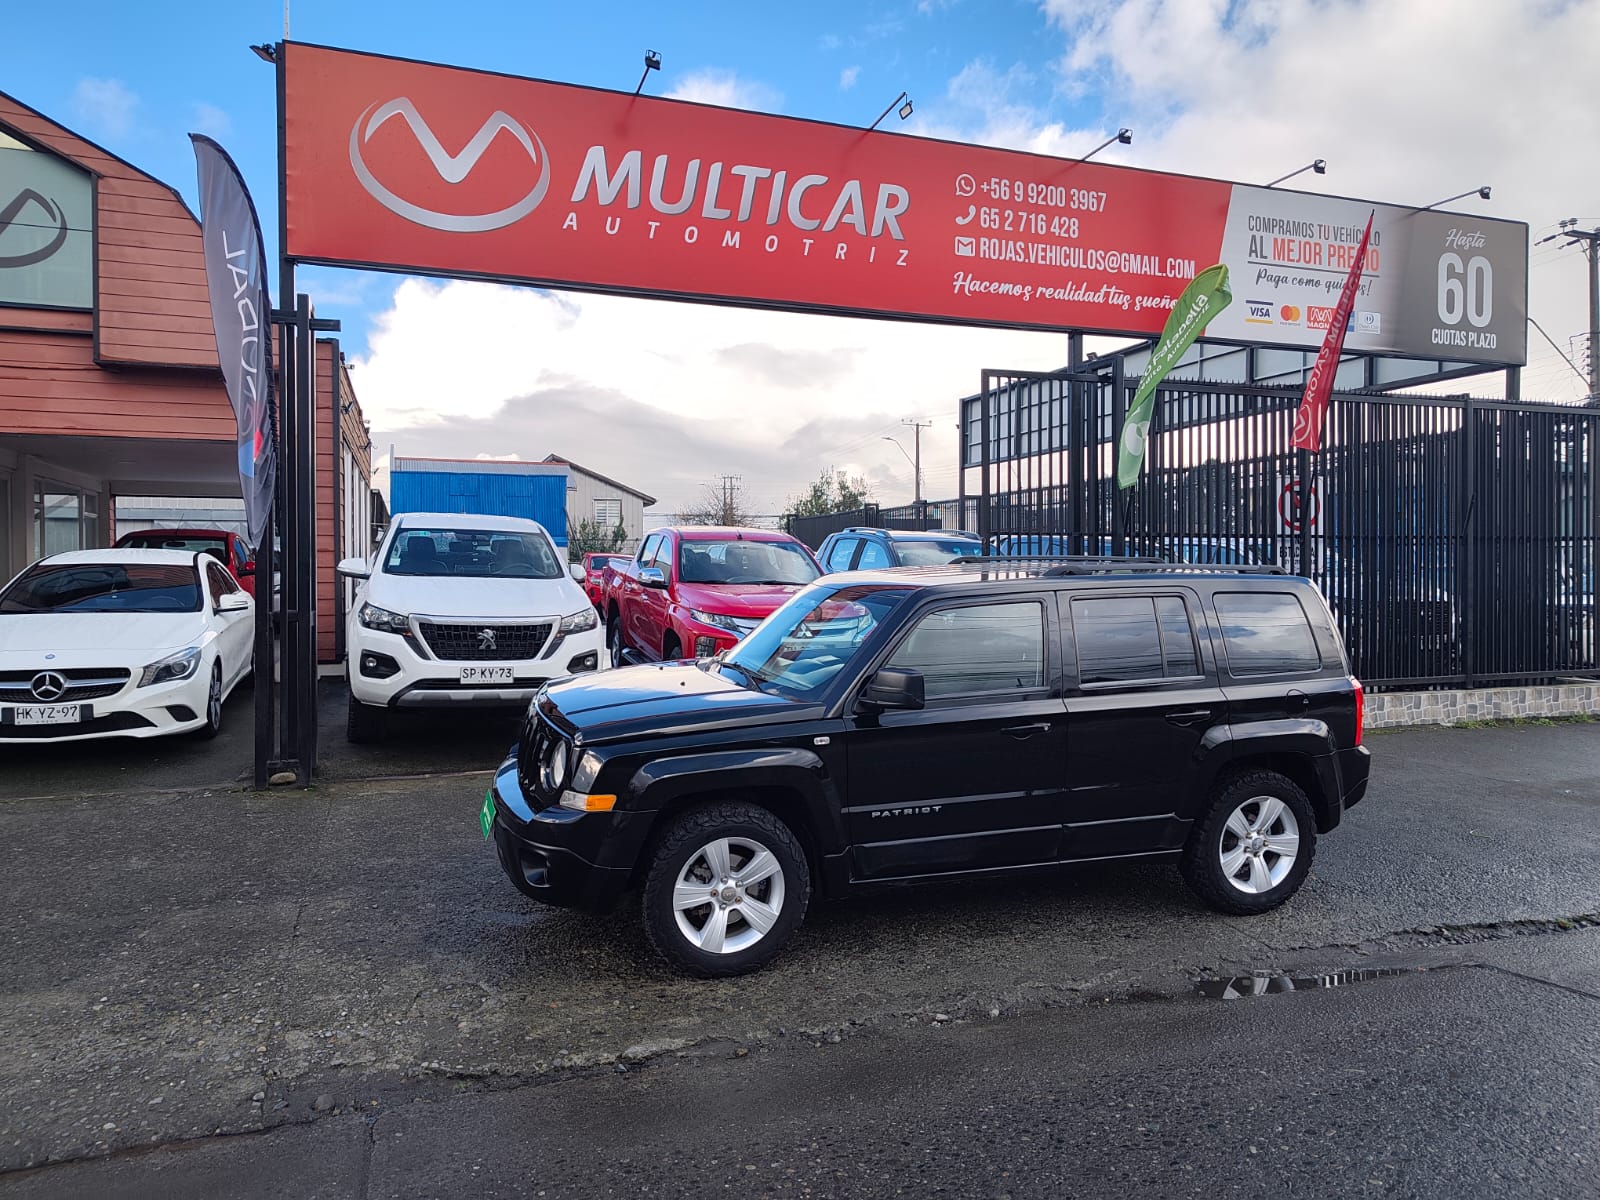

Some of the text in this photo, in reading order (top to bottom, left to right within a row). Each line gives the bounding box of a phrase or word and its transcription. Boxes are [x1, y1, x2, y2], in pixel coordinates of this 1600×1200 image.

[570, 145, 911, 241] MULTICAR
[980, 177, 1107, 213] +56 9 9200 3967
[562, 211, 910, 267] AUTOMOTRIZ
[980, 206, 1079, 239] 65 2 716 428
[1248, 215, 1381, 246] COMPRAMOS TU VEHÍCLO
[1445, 228, 1486, 250] Hasta
[979, 237, 1196, 280] ROJAS.VEHICULOS@GMAIL.COM
[1249, 234, 1380, 272] AL MEJOR PREIO
[953, 271, 1179, 312] Hacemos realidad tus sueño
[1256, 267, 1289, 286] Paga
[1291, 276, 1322, 288] como
[1437, 251, 1493, 328] 60
[1250, 306, 1271, 318] VISA
[1307, 321, 1331, 330] MAGN
[1431, 328, 1497, 349] CUOTAS PLAZO
[1306, 346, 1330, 402] ROJAS
[871, 805, 942, 818] PATRIOT
